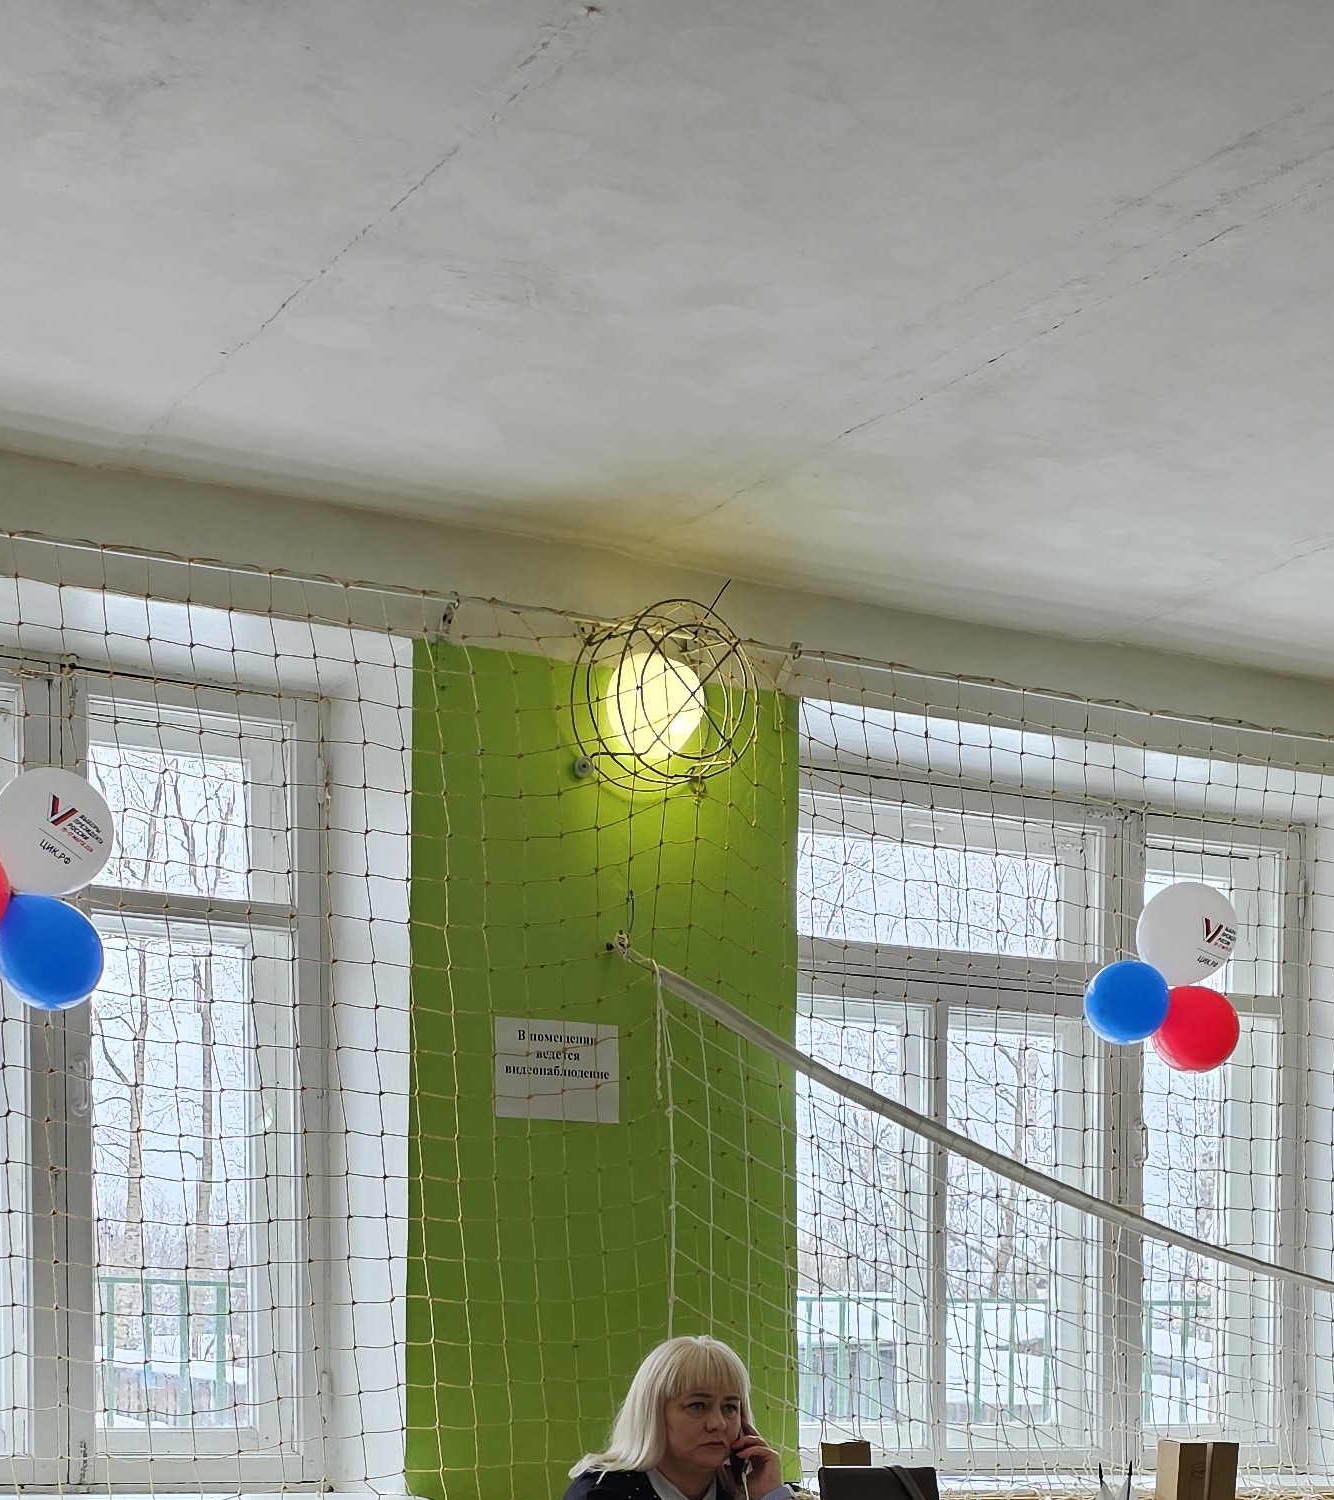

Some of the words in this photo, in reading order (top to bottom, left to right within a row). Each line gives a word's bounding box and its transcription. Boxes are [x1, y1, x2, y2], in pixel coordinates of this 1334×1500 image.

[67, 822, 90, 840] РОССИИ
[39, 838, 71, 865] ЦИК.РФ
[517, 1029, 526, 1041] В
[535, 1050, 580, 1061] ведется
[505, 1065, 610, 1080] видеонаблюдение
